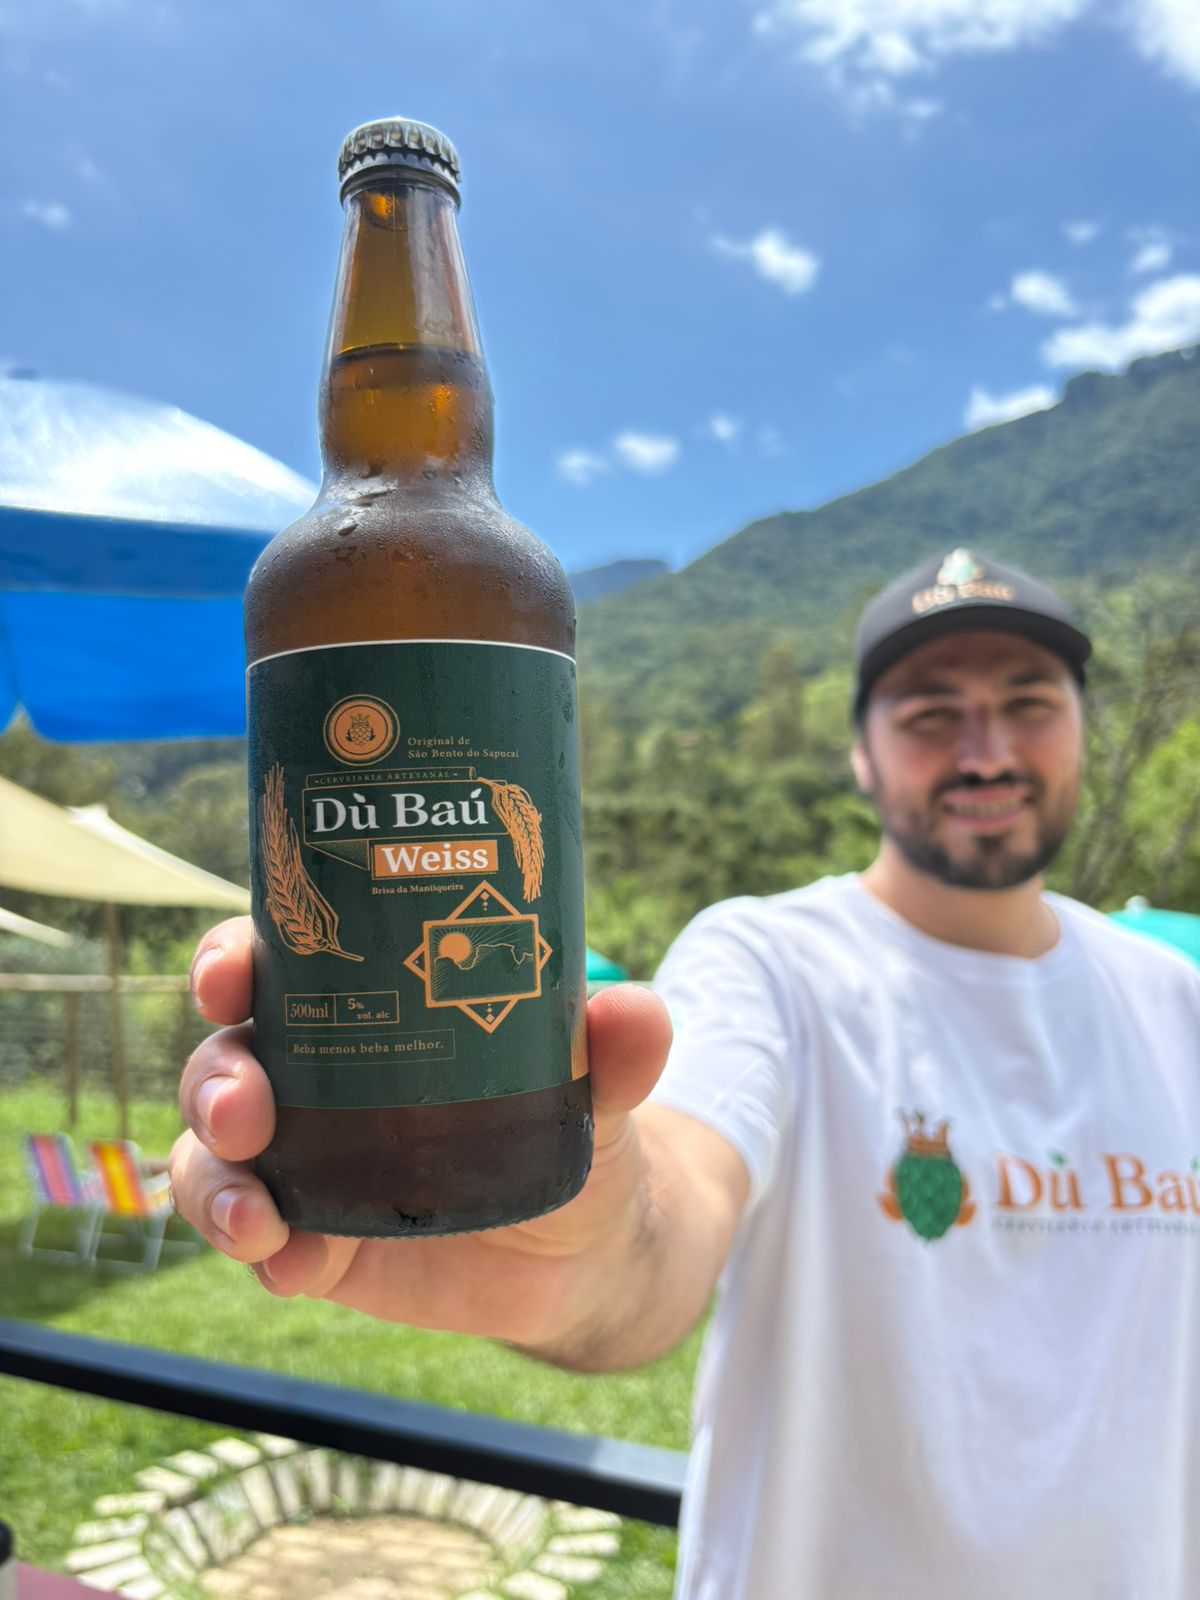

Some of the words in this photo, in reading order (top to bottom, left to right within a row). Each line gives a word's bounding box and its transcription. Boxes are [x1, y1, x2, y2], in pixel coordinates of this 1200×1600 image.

[407, 736, 454, 747] Original
[458, 736, 471, 745] de
[408, 749, 428, 758] São
[432, 748, 463, 758] Bento
[466, 748, 480, 757] do
[483, 748, 520, 759] Sapucaí
[387, 770, 450, 781] ARTESANAL
[311, 792, 380, 833] Dù
[390, 787, 489, 828] Baú
[381, 843, 489, 873] Weiss
[371, 886, 395, 895] Brisa
[396, 885, 408, 894] da
[409, 883, 465, 893] Mantiqueira
[290, 1003, 329, 1019] 500ml
[347, 998, 365, 1010] 5%
[293, 1044, 315, 1054] Beba
[319, 1044, 357, 1054] menos
[360, 1042, 390, 1053] beba
[394, 1039, 445, 1052] melhor.
